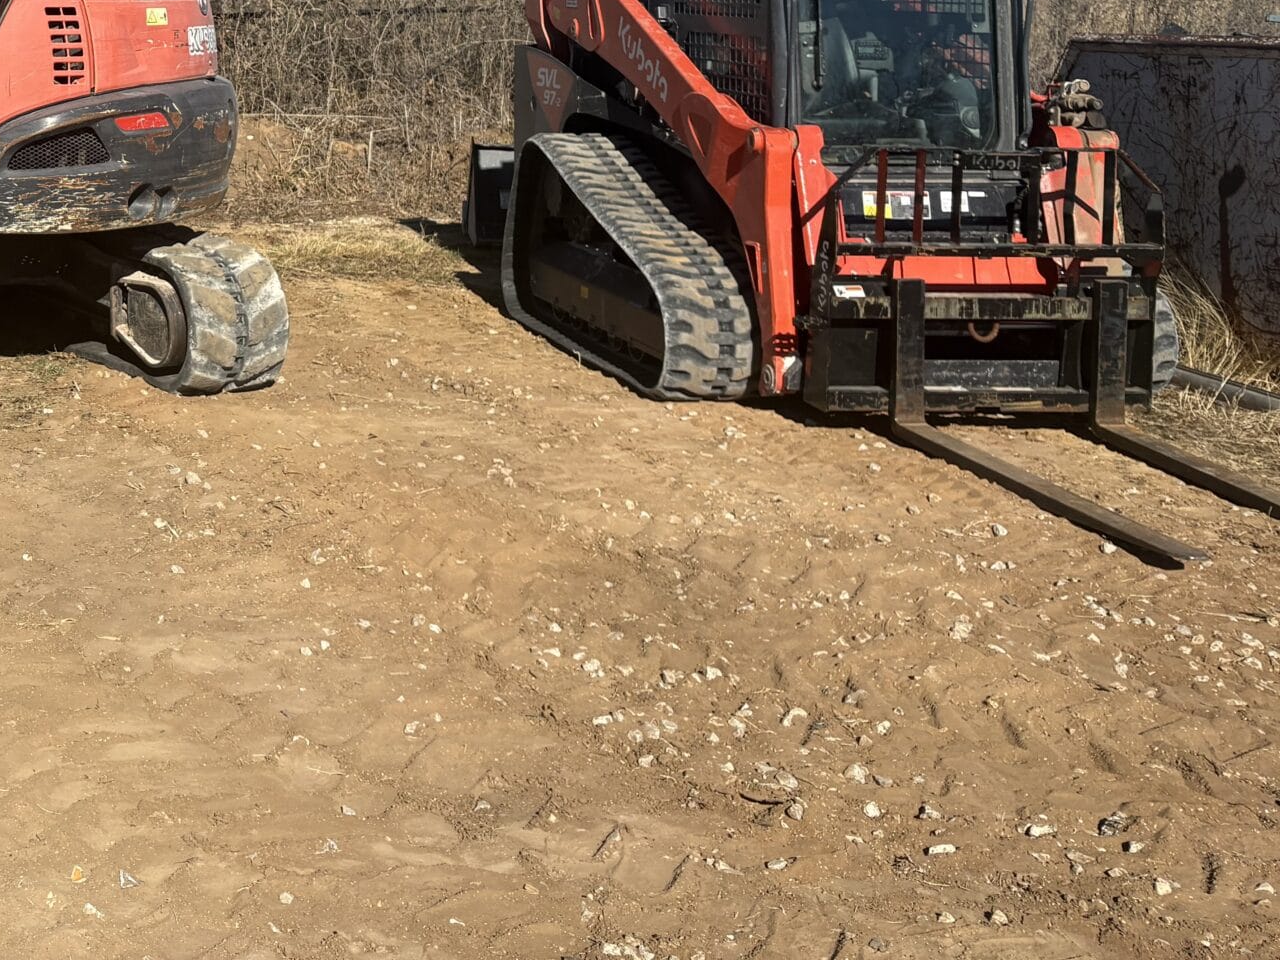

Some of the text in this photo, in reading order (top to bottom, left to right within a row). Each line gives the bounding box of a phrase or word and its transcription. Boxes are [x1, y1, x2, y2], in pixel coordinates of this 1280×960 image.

[536, 68, 561, 89] SVL
[618, 15, 668, 103] Kubota
[817, 240, 829, 312] Kubota
